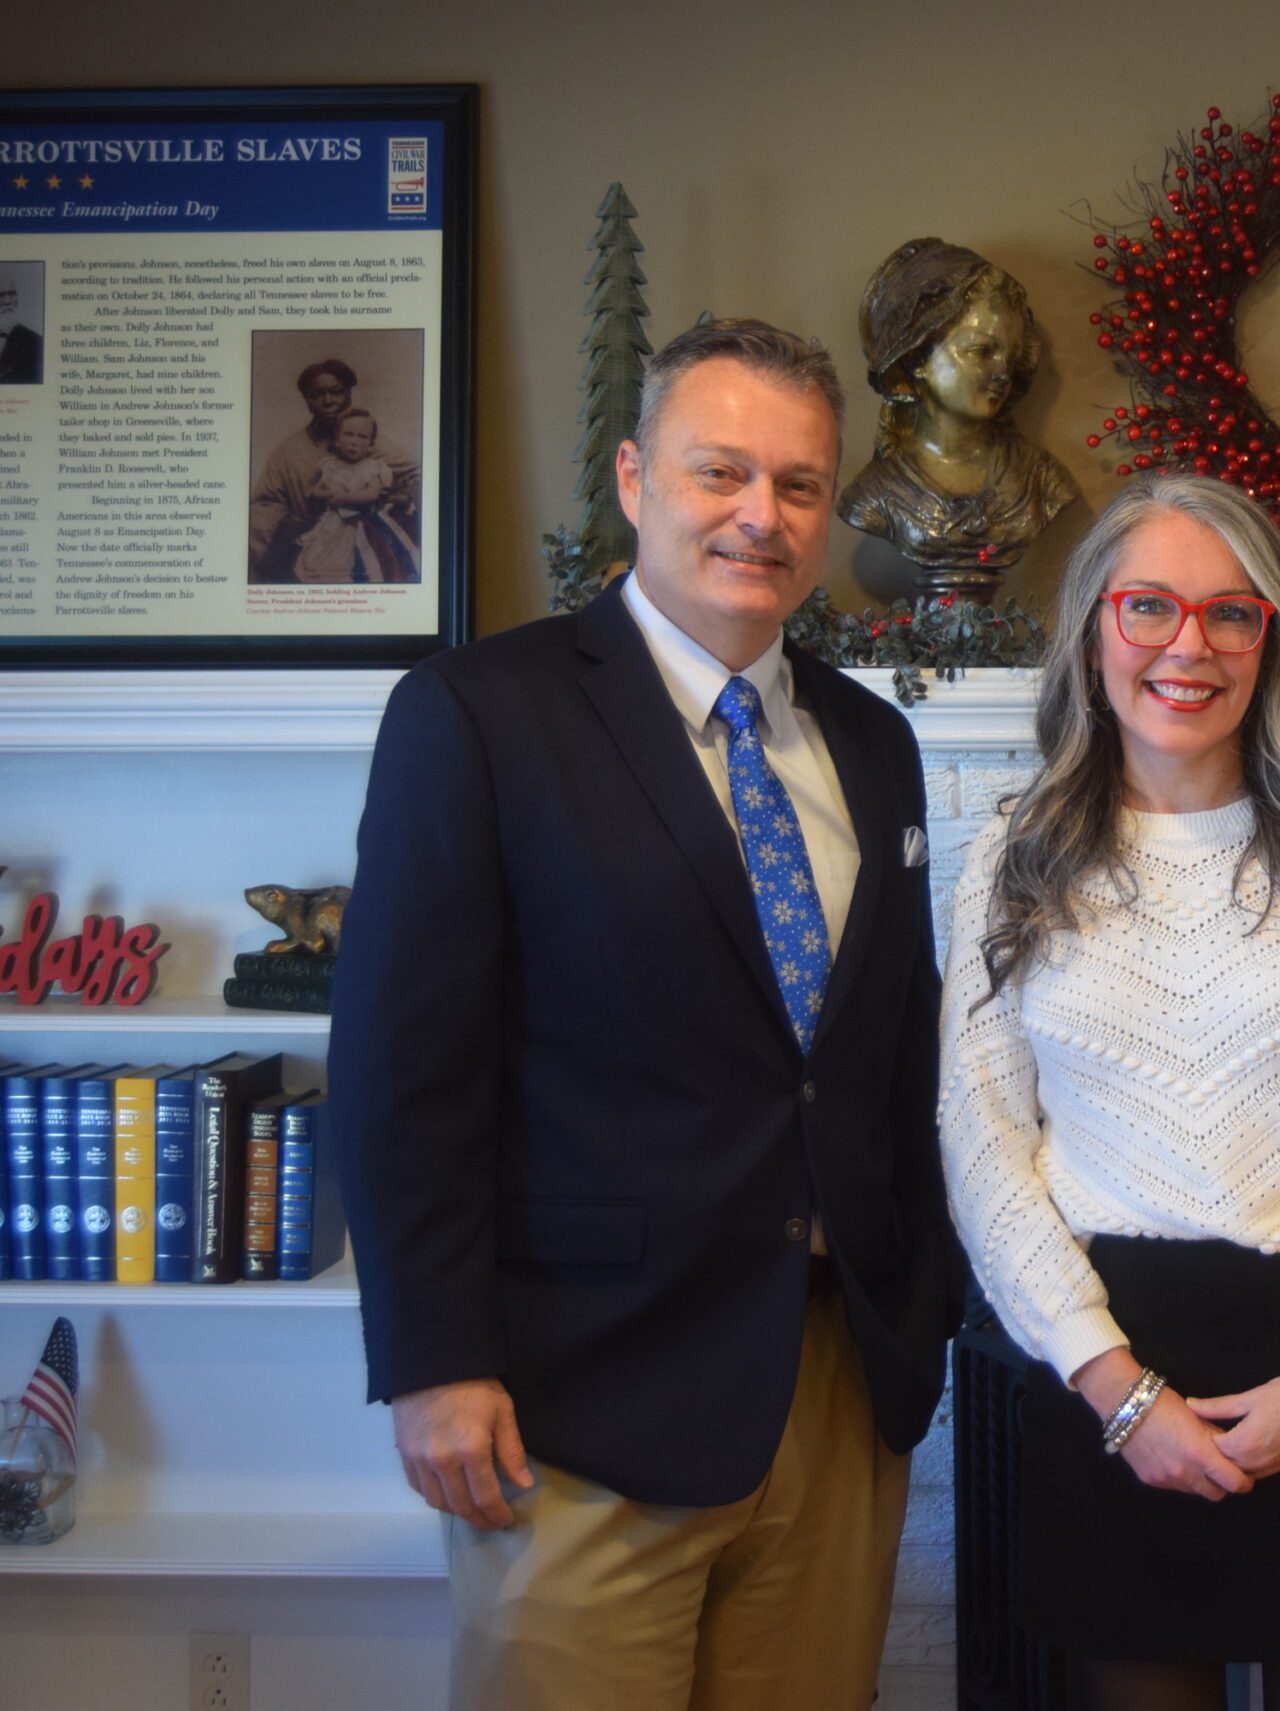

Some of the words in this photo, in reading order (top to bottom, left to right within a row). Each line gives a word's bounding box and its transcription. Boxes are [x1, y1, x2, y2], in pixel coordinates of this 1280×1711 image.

[238, 138, 361, 161] SLAVES
[392, 150, 408, 159] CIVIL
[409, 150, 425, 159] WAR
[392, 160, 424, 172] TRAILS
[62, 201, 178, 221] Emancipation
[184, 200, 219, 220] Day
[62, 260, 86, 269] tion's
[88, 261, 137, 271] provisions.
[139, 259, 181, 270] Johnson,
[184, 258, 240, 269] nonetheless,
[243, 258, 267, 268] freed
[270, 258, 284, 268] his
[308, 258, 336, 267] slaves
[353, 258, 387, 269] August
[389, 257, 397, 268] 8,
[402, 257, 425, 268] 1863,
[61, 275, 108, 287] according
[109, 276, 120, 285] to
[122, 274, 165, 285] tradition.
[169, 274, 183, 284] He
[185, 274, 224, 284] followed
[226, 274, 241, 284] his
[243, 274, 283, 286] personal
[286, 274, 315, 284] action
[317, 273, 339, 283] with
[356, 273, 388, 283] official
[390, 272, 422, 284] procla-
[61, 291, 94, 301] mation
[111, 290, 149, 300] October
[152, 291, 166, 301] 24,
[170, 290, 195, 301] 1864,
[197, 290, 242, 302] declaring
[244, 290, 256, 300] all
[258, 289, 308, 300] Tennessee
[310, 289, 339, 299] slaves
[341, 290, 351, 299] to
[353, 289, 365, 299] be
[367, 289, 388, 298] free.
[94, 306, 120, 316] After
[122, 306, 162, 316] Johnson
[165, 306, 207, 316] liberated
[210, 305, 235, 318] Dolly
[237, 305, 256, 315] and
[258, 306, 283, 316] Sam,
[286, 305, 307, 317] they
[309, 305, 330, 315] took
[333, 304, 348, 315] his
[74, 322, 98, 332] their
[126, 322, 151, 334] Dolly
[153, 321, 193, 332] Johnson
[196, 321, 214, 331] had
[60, 338, 87, 348] three
[88, 338, 131, 348] children,
[134, 338, 152, 348] Liz,
[155, 337, 198, 348] Florence,
[201, 337, 219, 347] and
[60, 353, 99, 364] William.
[103, 354, 125, 363] Sam
[127, 353, 168, 363] Johnson
[170, 353, 189, 363] and
[191, 353, 206, 363] his
[60, 369, 82, 380] wife,
[86, 369, 133, 381] Margaret,
[136, 369, 154, 379] had
[157, 370, 179, 379] nine
[181, 369, 222, 379] children.
[60, 385, 85, 397] Dolly
[87, 385, 127, 395] Johnson
[130, 385, 153, 395] lived
[155, 385, 177, 394] with
[180, 384, 196, 394] her
[59, 417, 85, 426] tailor
[88, 416, 110, 428] shop
[113, 417, 123, 426] in
[125, 416, 182, 426] Greeneville,
[185, 416, 214, 426] where
[59, 432, 80, 444] they
[82, 432, 112, 442] baked
[113, 432, 132, 442] and
[135, 432, 154, 442] sold
[156, 433, 178, 444] pies.
[181, 432, 192, 441] In
[196, 432, 219, 443] 1937,
[59, 448, 96, 458] William
[99, 448, 139, 457] Johnson
[163, 448, 208, 457] President
[59, 464, 101, 473] Franklin
[105, 464, 114, 473] D.
[118, 464, 166, 474] Roosevelt,
[169, 464, 189, 473] who
[58, 480, 104, 491] presented
[107, 480, 126, 489] him
[138, 479, 200, 489] silver-headed
[0, 496, 40, 506] military
[57, 543, 78, 552] Now
[81, 543, 97, 552] the
[99, 543, 120, 552] date
[123, 542, 163, 553] officially
[167, 542, 197, 552] marks
[56, 558, 112, 568] Tennessee's
[114, 560, 191, 568] commemoration
[193, 558, 204, 567] of
[56, 574, 93, 583] Andrew
[95, 574, 141, 583] Johnson's
[142, 574, 181, 583] decision
[195, 574, 228, 583] bestow
[55, 605, 115, 615] Parrottsville
[118, 605, 148, 614] slaves.
[209, 1107, 220, 1134] Legal
[206, 1135, 220, 1180] Question
[208, 1180, 219, 1190] &
[207, 1191, 218, 1228] Answer
[206, 1228, 218, 1256] Book
